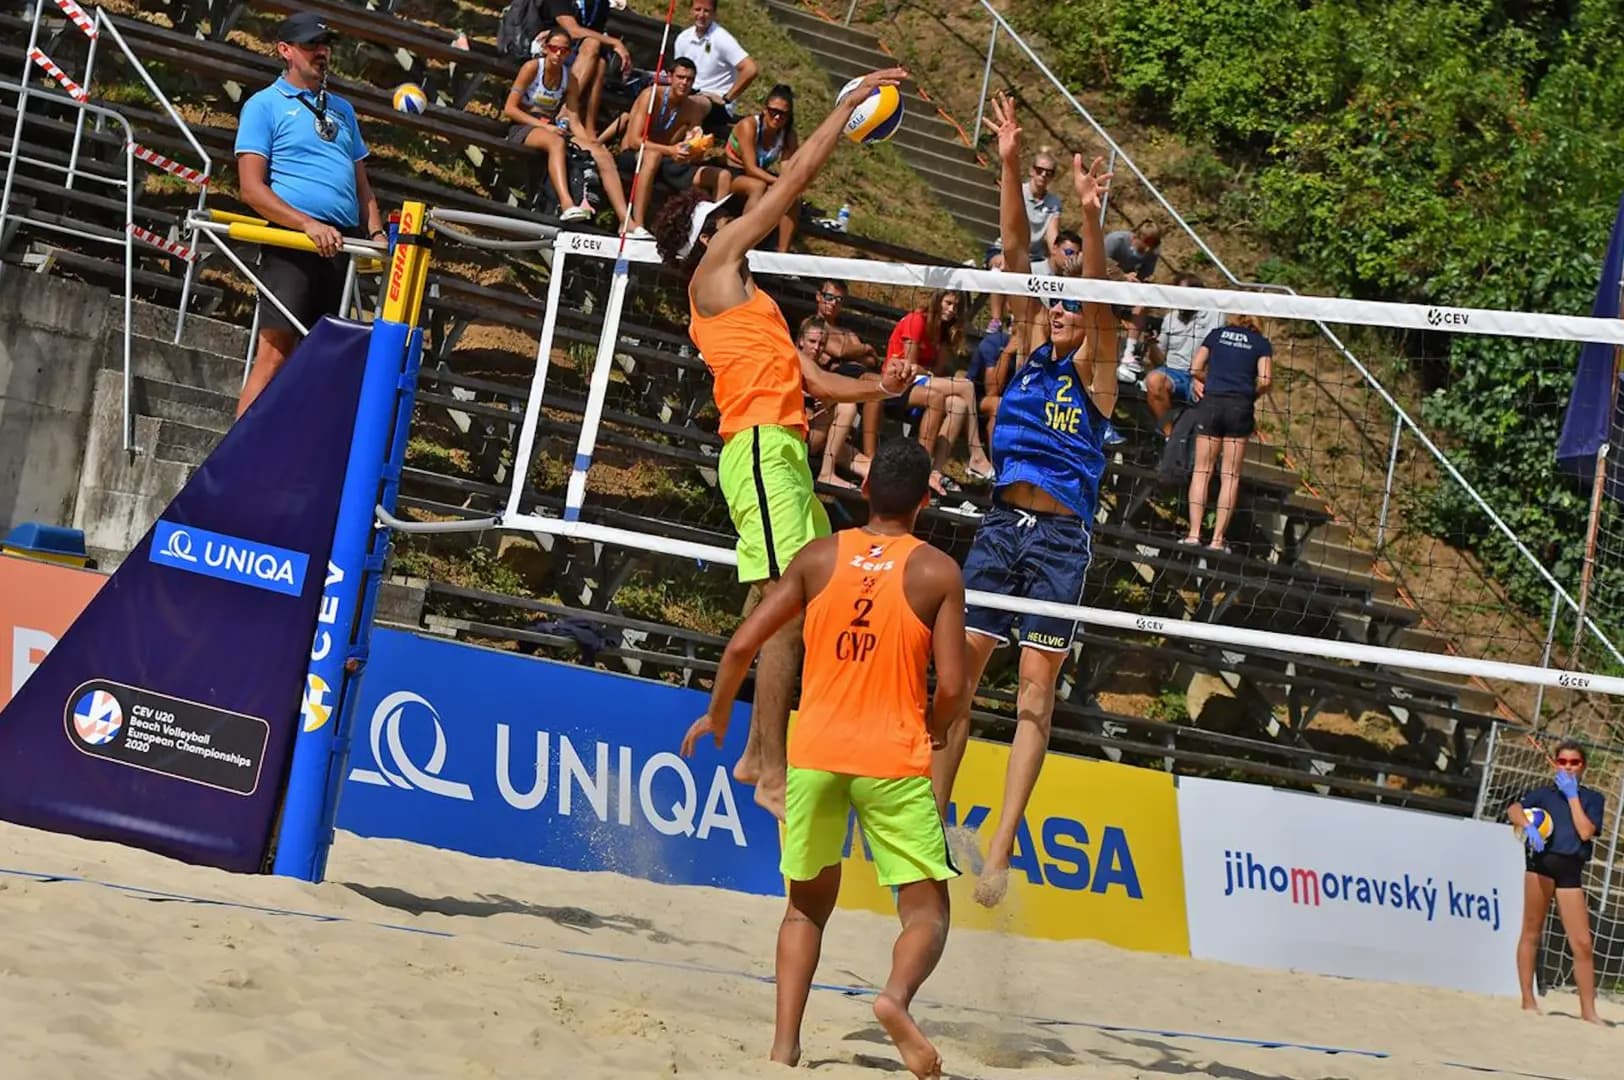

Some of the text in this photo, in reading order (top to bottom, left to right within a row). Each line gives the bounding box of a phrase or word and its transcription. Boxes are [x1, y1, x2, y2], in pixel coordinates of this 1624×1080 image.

[583, 239, 602, 250] CEV
[1042, 281, 1064, 292] CEV
[1444, 313, 1469, 324] CEV
[1056, 375, 1073, 402] 2
[1045, 402, 1082, 434] SWE
[204, 541, 295, 585] UNIQA
[311, 560, 345, 661] CEV
[850, 598, 873, 628] 2
[1026, 631, 1065, 647] HELLVIG
[1146, 620, 1164, 631] CEV
[835, 631, 876, 662] CYP
[1571, 677, 1590, 688] CEV
[132, 705, 175, 724] CEV U20
[129, 715, 211, 746] Beach Volleyball
[124, 738, 150, 753] 2020
[127, 727, 251, 768] European Championships
[496, 723, 747, 847] UNIQA
[1224, 850, 1500, 931] jihomoravský kraj
